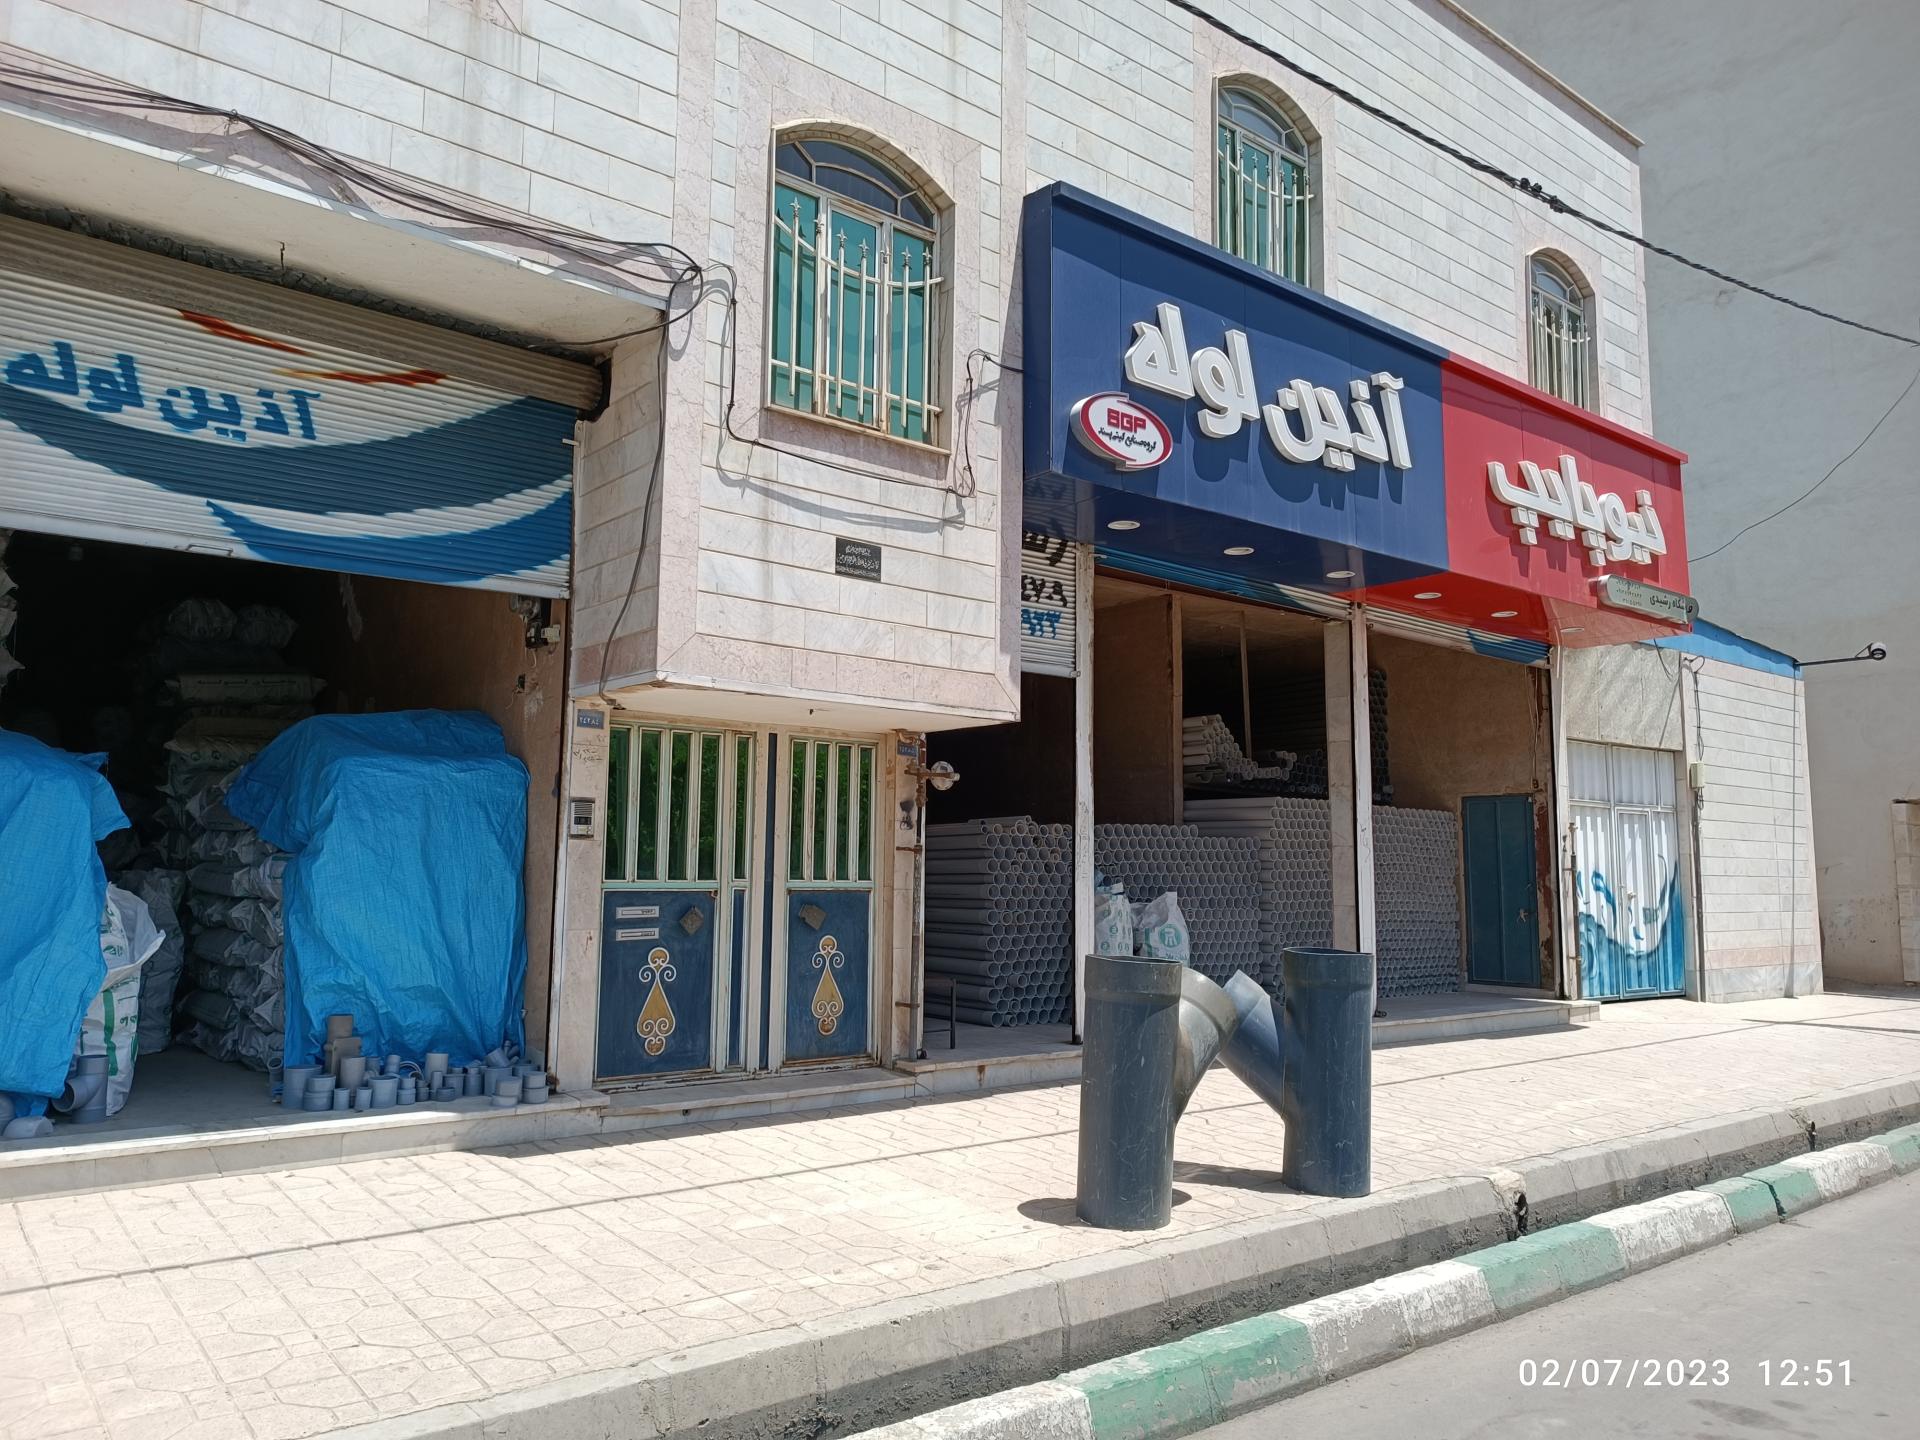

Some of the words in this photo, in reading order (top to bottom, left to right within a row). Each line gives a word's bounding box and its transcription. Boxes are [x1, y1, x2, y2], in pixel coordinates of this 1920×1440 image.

[4, 341, 145, 413] لوله
[1124, 302, 1260, 438] لوله
[157, 386, 320, 442] آذین
[1262, 371, 1412, 472] آذین
[1649, 594, 1672, 610] رشیدی
